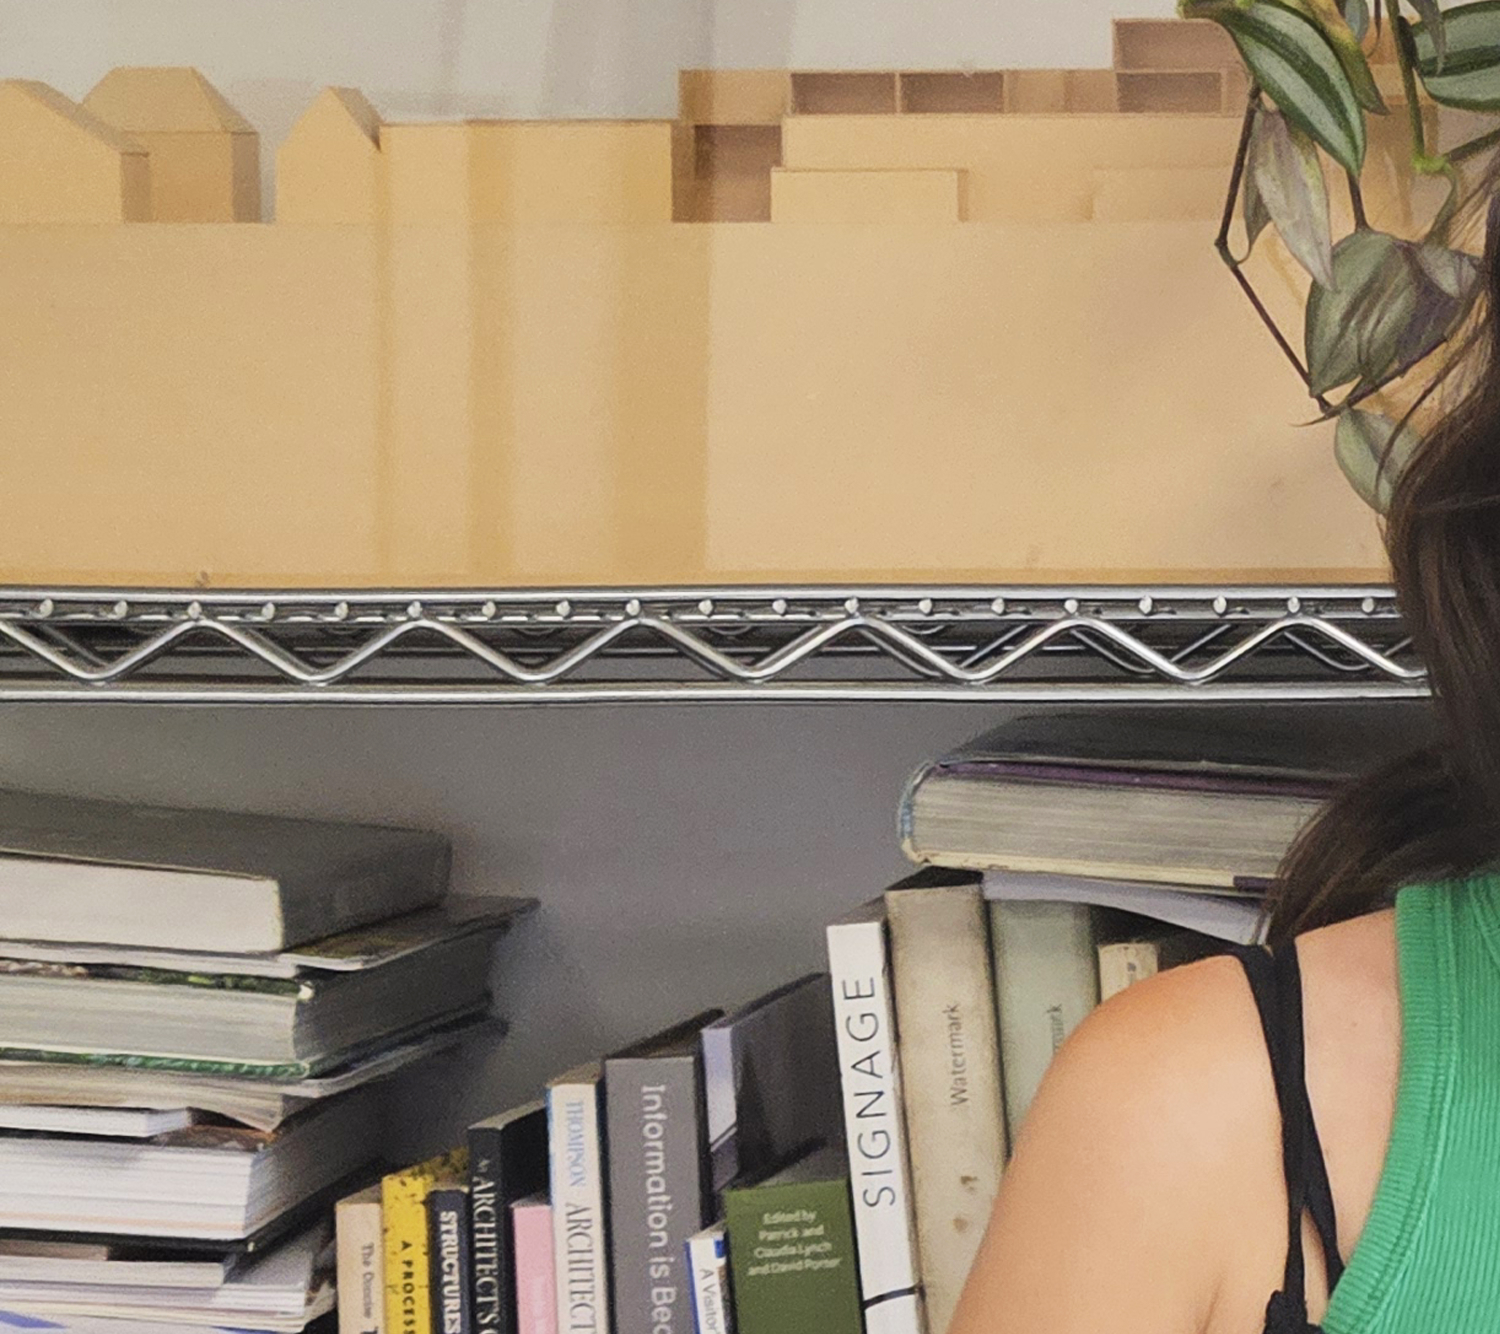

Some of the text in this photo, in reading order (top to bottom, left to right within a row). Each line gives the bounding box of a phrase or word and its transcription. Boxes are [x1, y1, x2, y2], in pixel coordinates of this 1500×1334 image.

[842, 977, 895, 1208] SIGNAGE
[943, 1003, 968, 1107] Watermark
[567, 1100, 586, 1186] THOMPSON
[642, 1084, 674, 1248] Information
[401, 1240, 412, 1251] A
[439, 1211, 460, 1334] STRUCTURES
[472, 1176, 500, 1324] ARCHITECT'S
[649, 1256, 676, 1278] is
[699, 1268, 713, 1280] A
